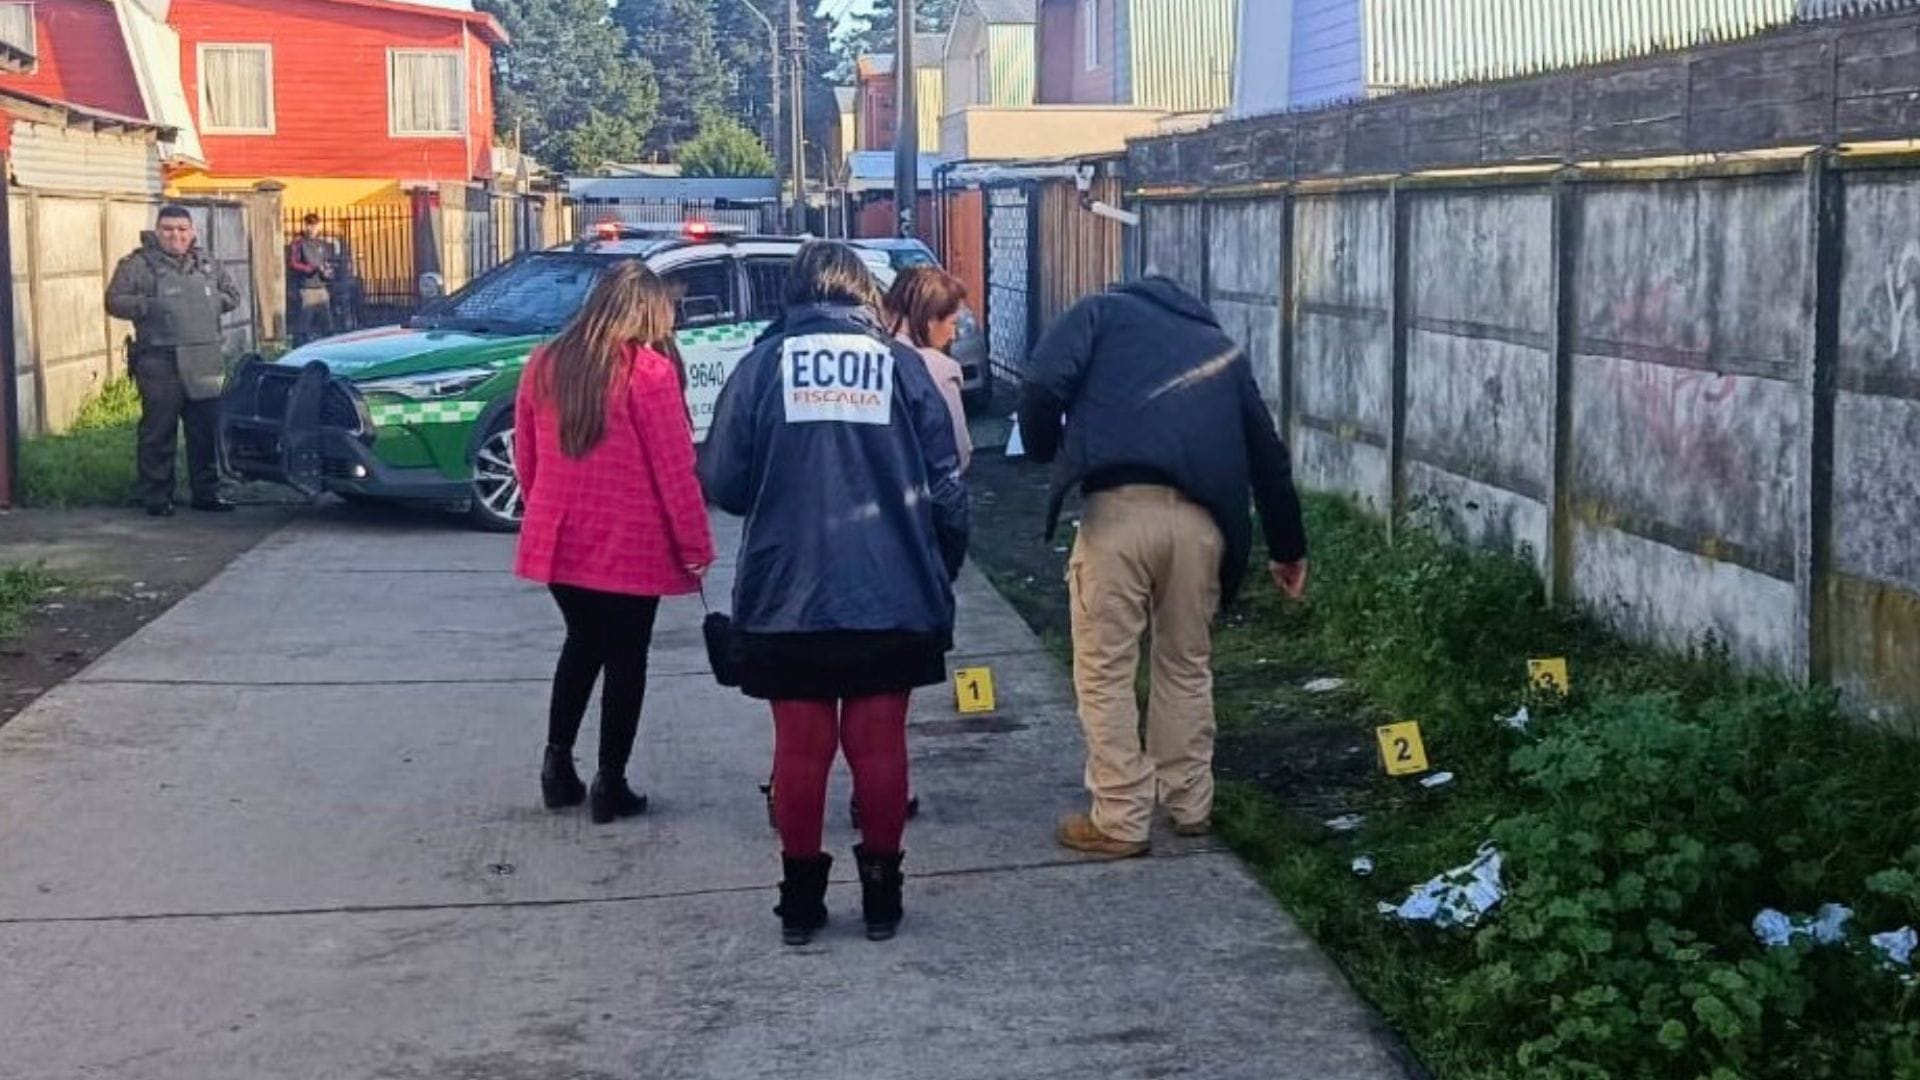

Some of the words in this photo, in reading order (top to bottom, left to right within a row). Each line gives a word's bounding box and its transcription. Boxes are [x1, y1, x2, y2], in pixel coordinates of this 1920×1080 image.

[690, 361, 725, 388] 9640
[792, 349, 885, 391] ECOH
[793, 390, 881, 406] FISCALIA
[967, 679, 979, 701] 1
[1393, 737, 1412, 762] 2
